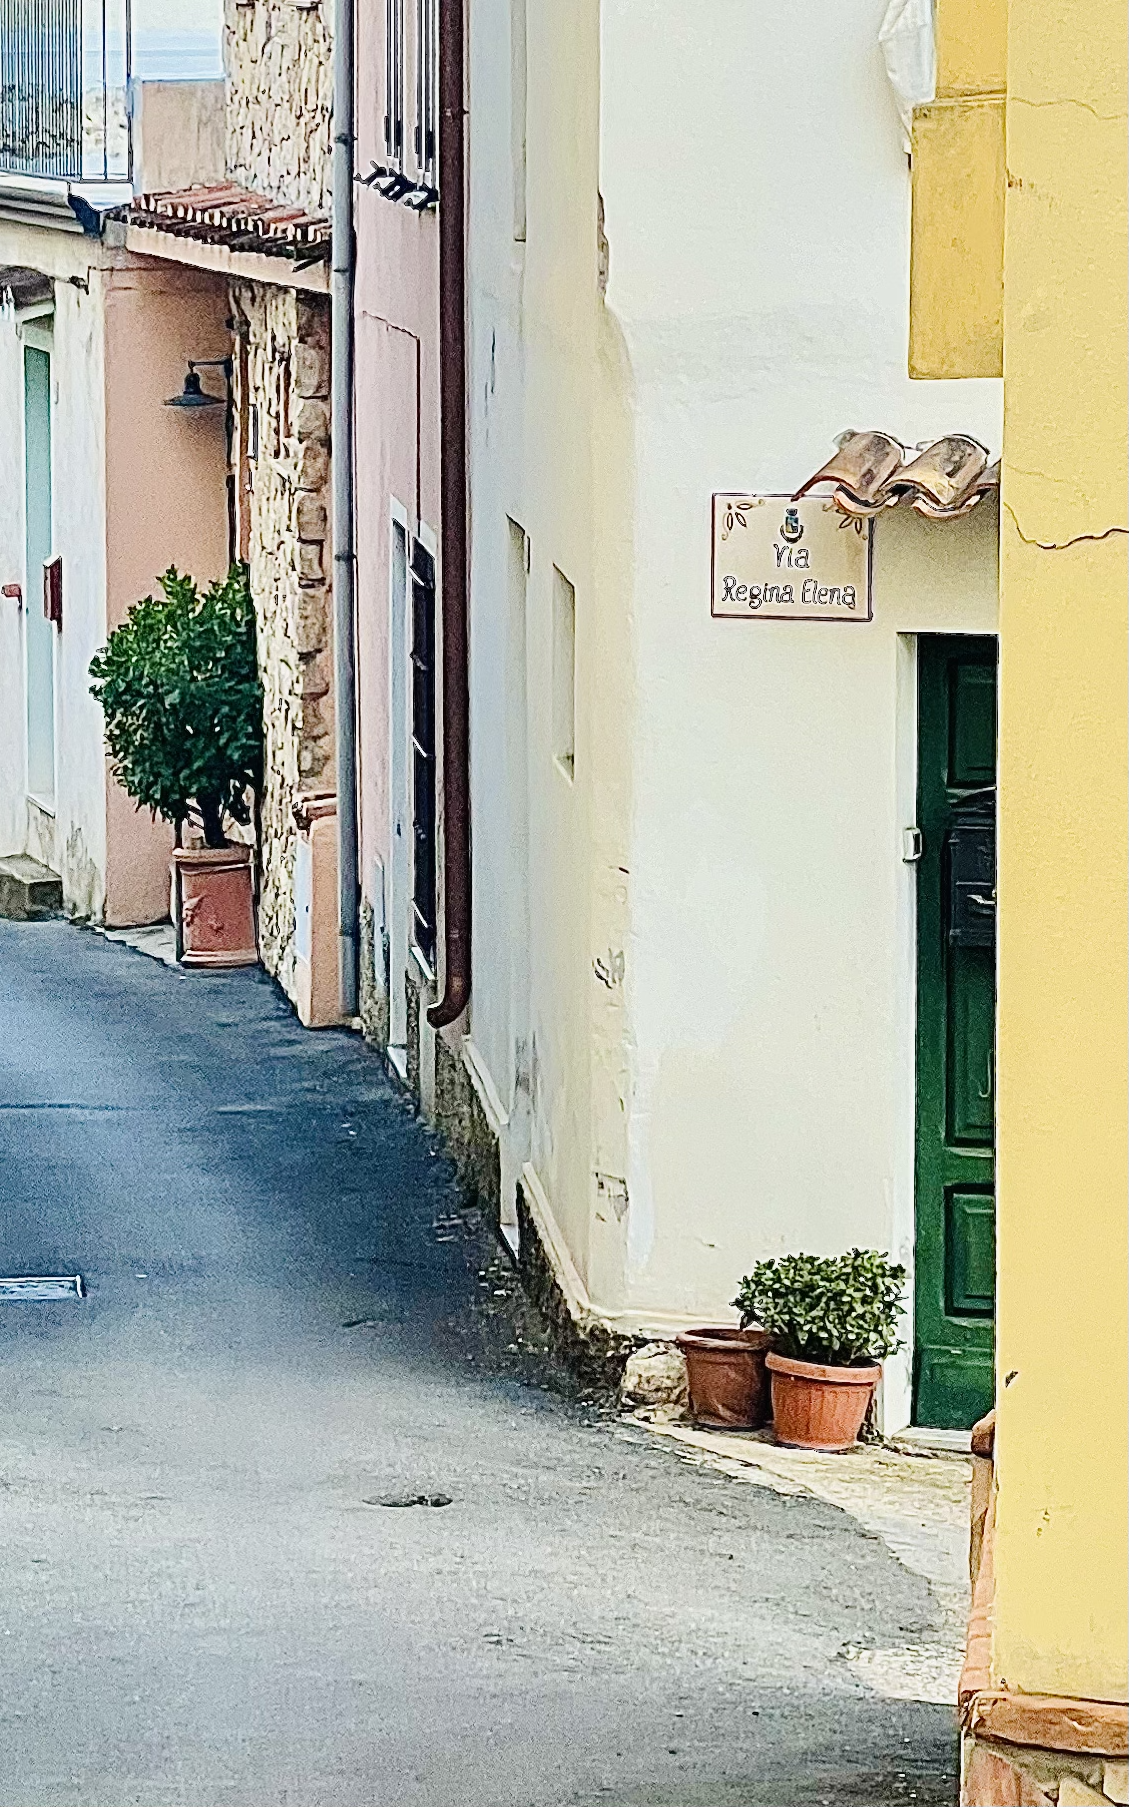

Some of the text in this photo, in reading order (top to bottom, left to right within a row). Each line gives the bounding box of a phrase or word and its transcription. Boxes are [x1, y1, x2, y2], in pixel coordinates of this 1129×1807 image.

[773, 544, 810, 569] Via
[722, 576, 856, 609] Regina Elena
